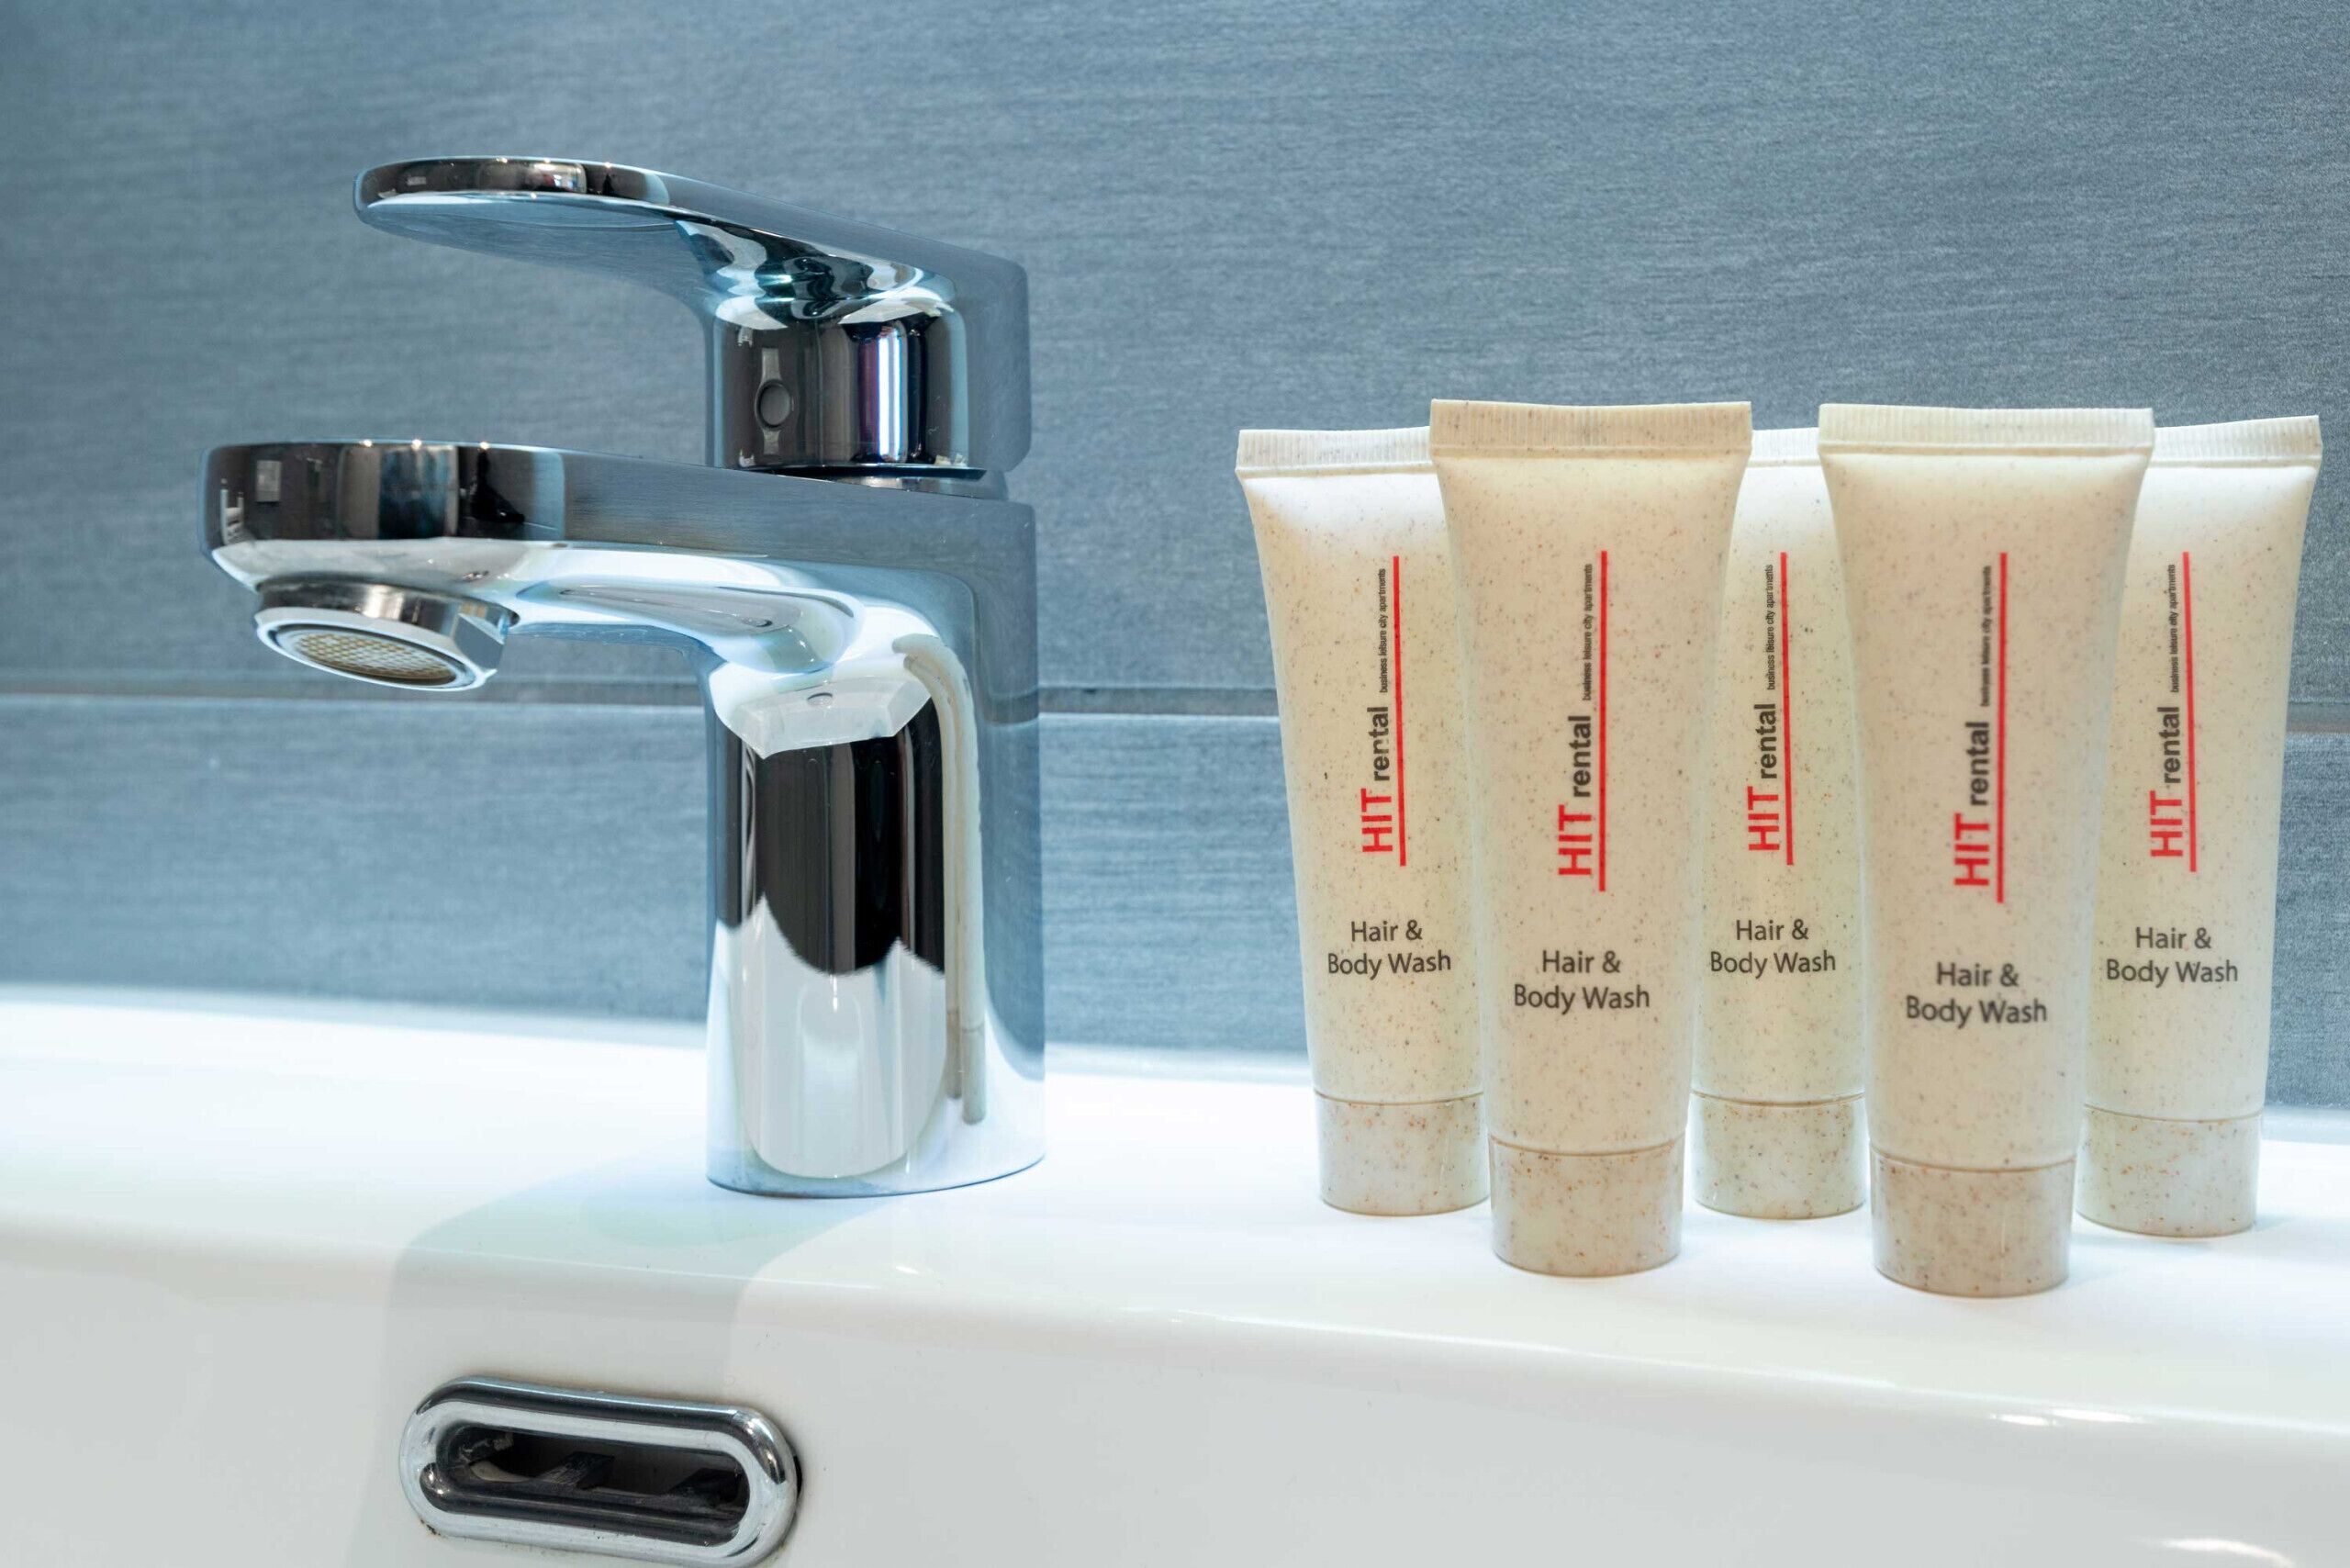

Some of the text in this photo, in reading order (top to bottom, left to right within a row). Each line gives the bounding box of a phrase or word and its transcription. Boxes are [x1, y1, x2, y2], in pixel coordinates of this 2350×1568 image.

[2166, 565, 2177, 609] apartments
[2169, 657, 2179, 692] business
[1360, 568, 1393, 853] HIT rental business leisure city apartments
[1558, 564, 1595, 876] HIT rental business leisure city apartments
[1747, 565, 1780, 851] HIT rental business leisure city apartments
[2157, 707, 2180, 783] rental
[1965, 722, 1990, 806] rental
[2149, 790, 2183, 857] HIT
[1953, 813, 1990, 887] HIT
[1350, 920, 1423, 942] Hair &
[1736, 919, 1808, 941] Hair &
[2136, 927, 2211, 949] Hair &
[1327, 949, 1451, 980] Body Wash
[1543, 950, 1621, 973] Hair &
[1710, 949, 1836, 978] Body Wash
[1937, 962, 2019, 987] Hair &
[2107, 958, 2238, 988] Body Wash
[1514, 983, 1650, 1014] Body Wash
[1907, 995, 2047, 1028] Body Wash
